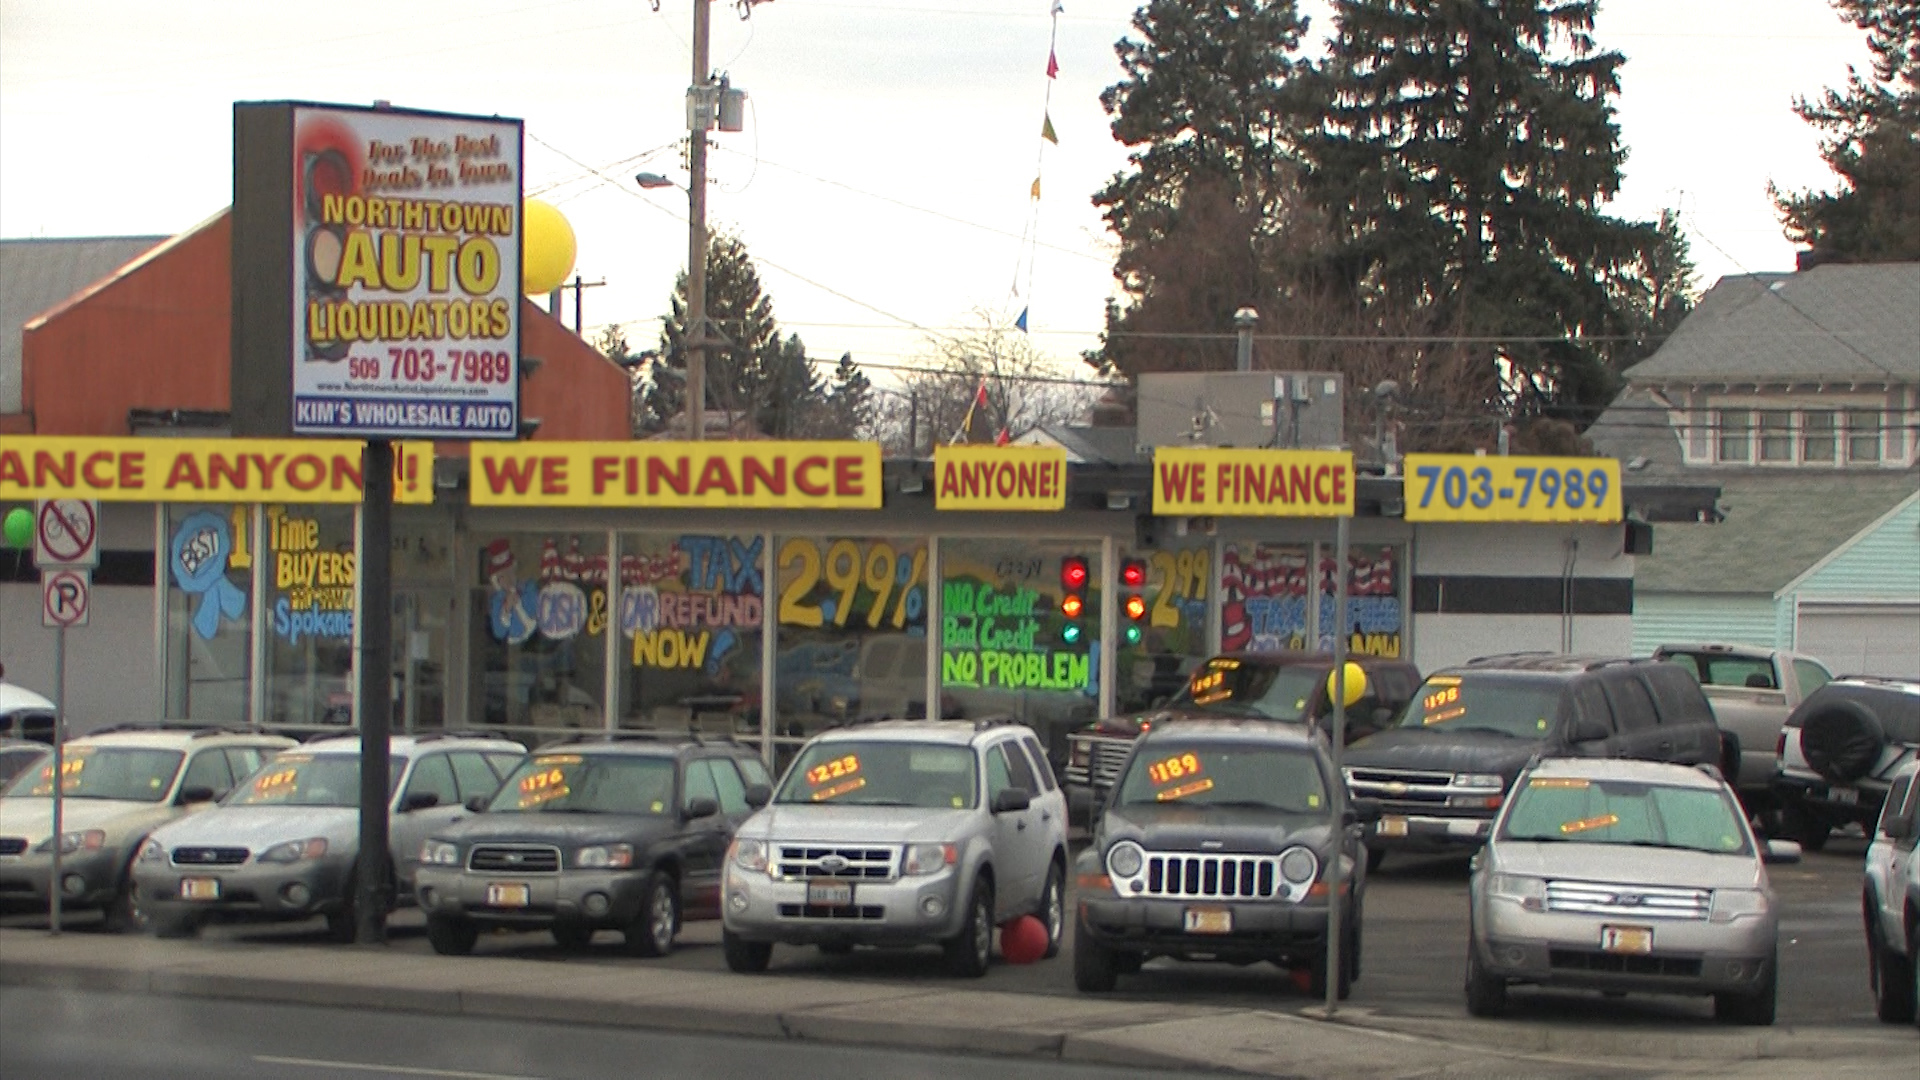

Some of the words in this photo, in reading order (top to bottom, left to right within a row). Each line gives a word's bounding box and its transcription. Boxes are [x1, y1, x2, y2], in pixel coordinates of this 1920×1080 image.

[410, 136, 450, 162] The
[454, 133, 499, 159] Best
[362, 166, 422, 191] Deals
[323, 193, 512, 235] NORTHTOWN
[336, 230, 501, 295] AUTO
[308, 298, 510, 341] LIQUIDATORS
[349, 357, 380, 380] 509
[388, 347, 511, 384] 703-7989
[298, 402, 351, 425] KIM'S
[355, 404, 461, 427] WHOLESALE
[464, 407, 511, 428] AUTO
[164, 453, 420, 491] ANYON!
[482, 456, 569, 495] WE
[592, 456, 865, 496] FINANCE
[940, 460, 1060, 499] ANYONE!
[1160, 463, 1206, 503] WE
[1217, 465, 1347, 506] FINANCE
[1416, 465, 1609, 509] 703-7989
[268, 504, 319, 550] Time
[277, 551, 355, 588] BUYERS
[680, 536, 765, 594] TAX
[659, 591, 763, 627] REFUND
[943, 582, 975, 616] NO
[976, 581, 1039, 616] Credit
[276, 597, 354, 646] Spokane
[943, 616, 977, 650] Bad
[980, 617, 1039, 650] Credit
[943, 651, 977, 687] NO
